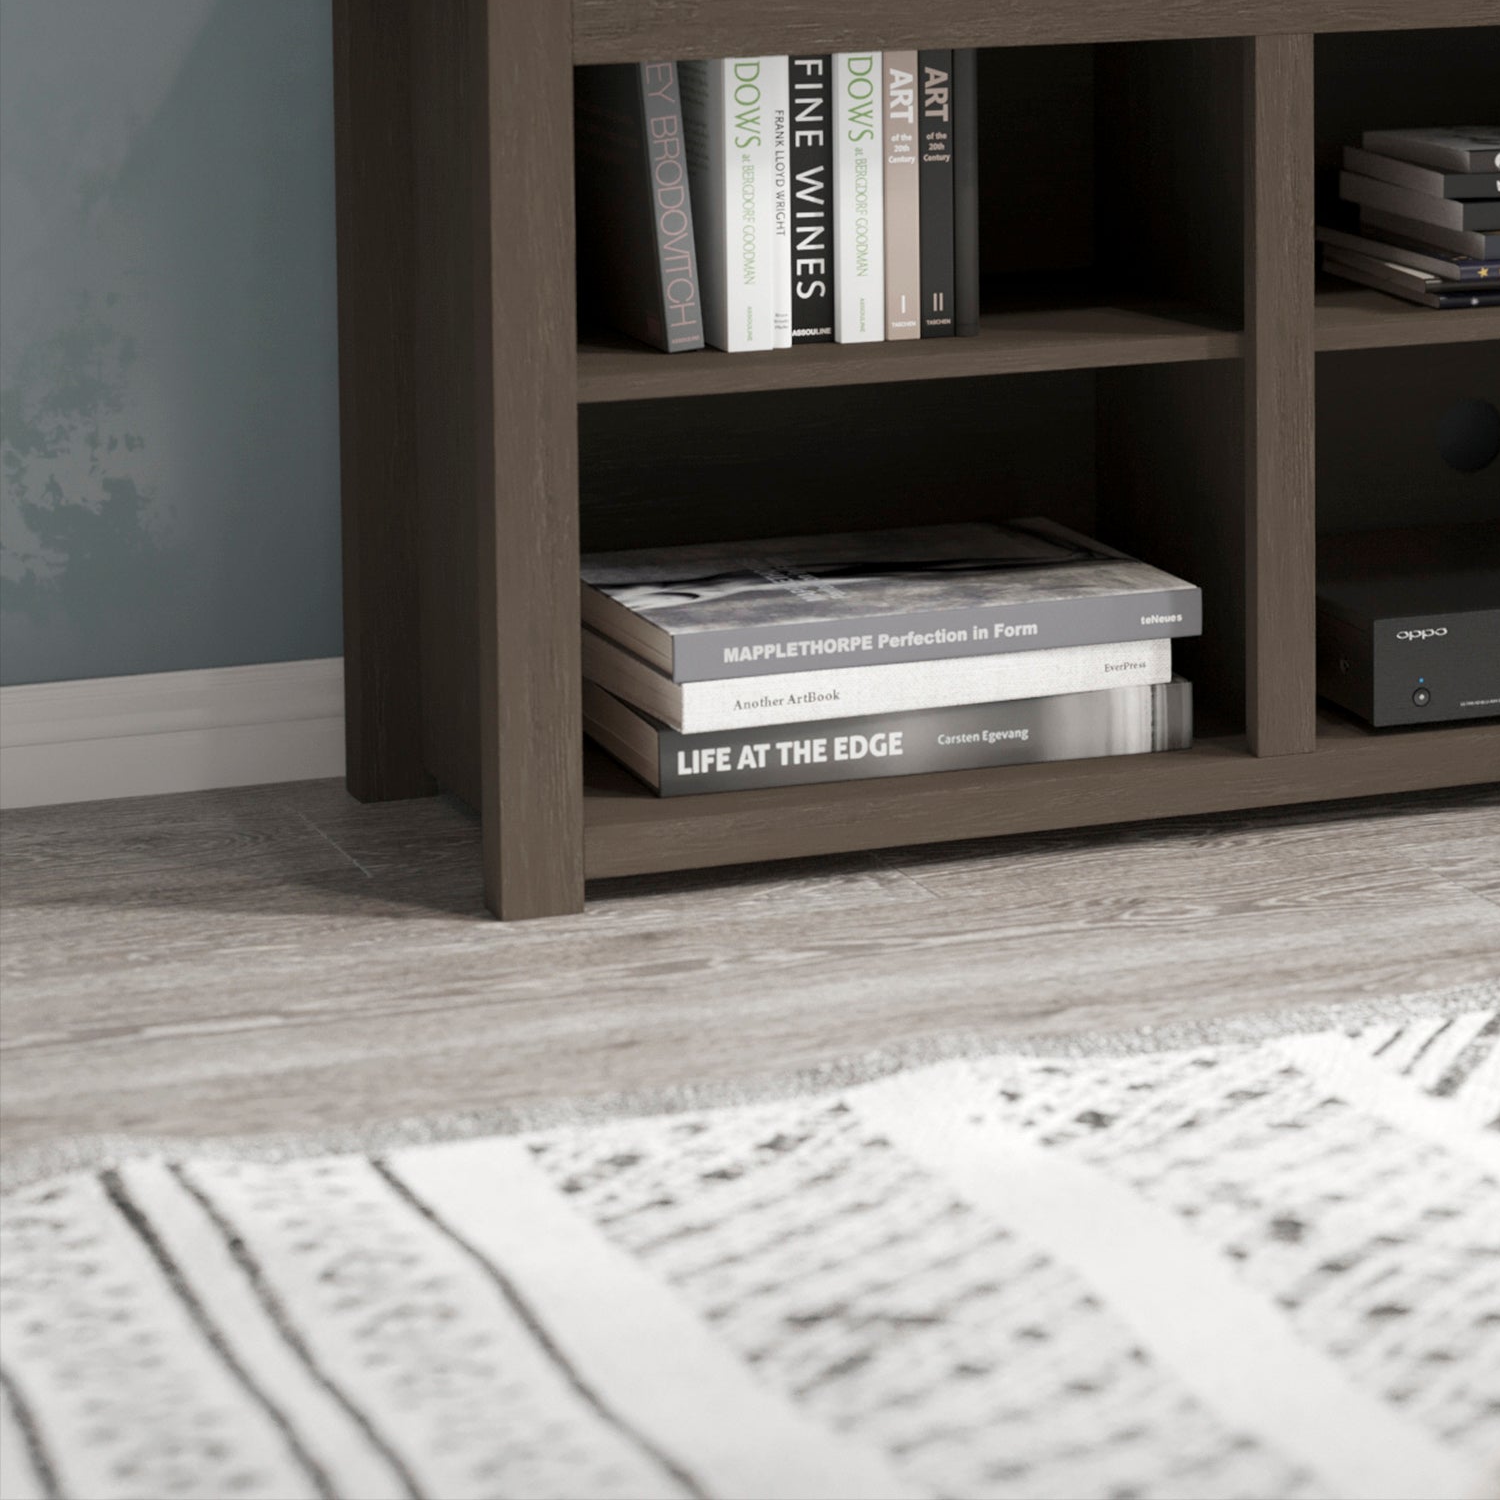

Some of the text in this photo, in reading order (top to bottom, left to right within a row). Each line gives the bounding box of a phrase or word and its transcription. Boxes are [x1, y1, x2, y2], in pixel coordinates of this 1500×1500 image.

[645, 60, 676, 104] EY
[847, 55, 874, 143] DOWS
[889, 67, 914, 124] ART
[924, 66, 949, 123] ART
[734, 62, 761, 149] DOWS
[891, 132, 913, 143] of the
[923, 153, 951, 163] Century
[926, 131, 948, 141] of the
[775, 109, 786, 237] FRANK LLOYD WRIGHT
[794, 59, 826, 299] FINE WINES
[888, 155, 916, 165] Century
[742, 165, 755, 223] BERGDORF
[855, 158, 869, 215] BERGDORF
[650, 115, 697, 328] BRODOVITCH
[743, 225, 756, 286] GOODMAN
[855, 217, 869, 277] GOODMAN
[792, 327, 832, 337] ASSOULINE
[1140, 612, 1183, 625] teNeues
[1396, 627, 1448, 640] oppo
[723, 622, 1038, 664] MAPPLETHORPE Perfection in Form
[1104, 660, 1147, 673] EverPress
[733, 689, 841, 711] Another ArtBook
[677, 731, 904, 776] LIFE AT THE EDGE
[937, 727, 1030, 746] Carsten Egevang
